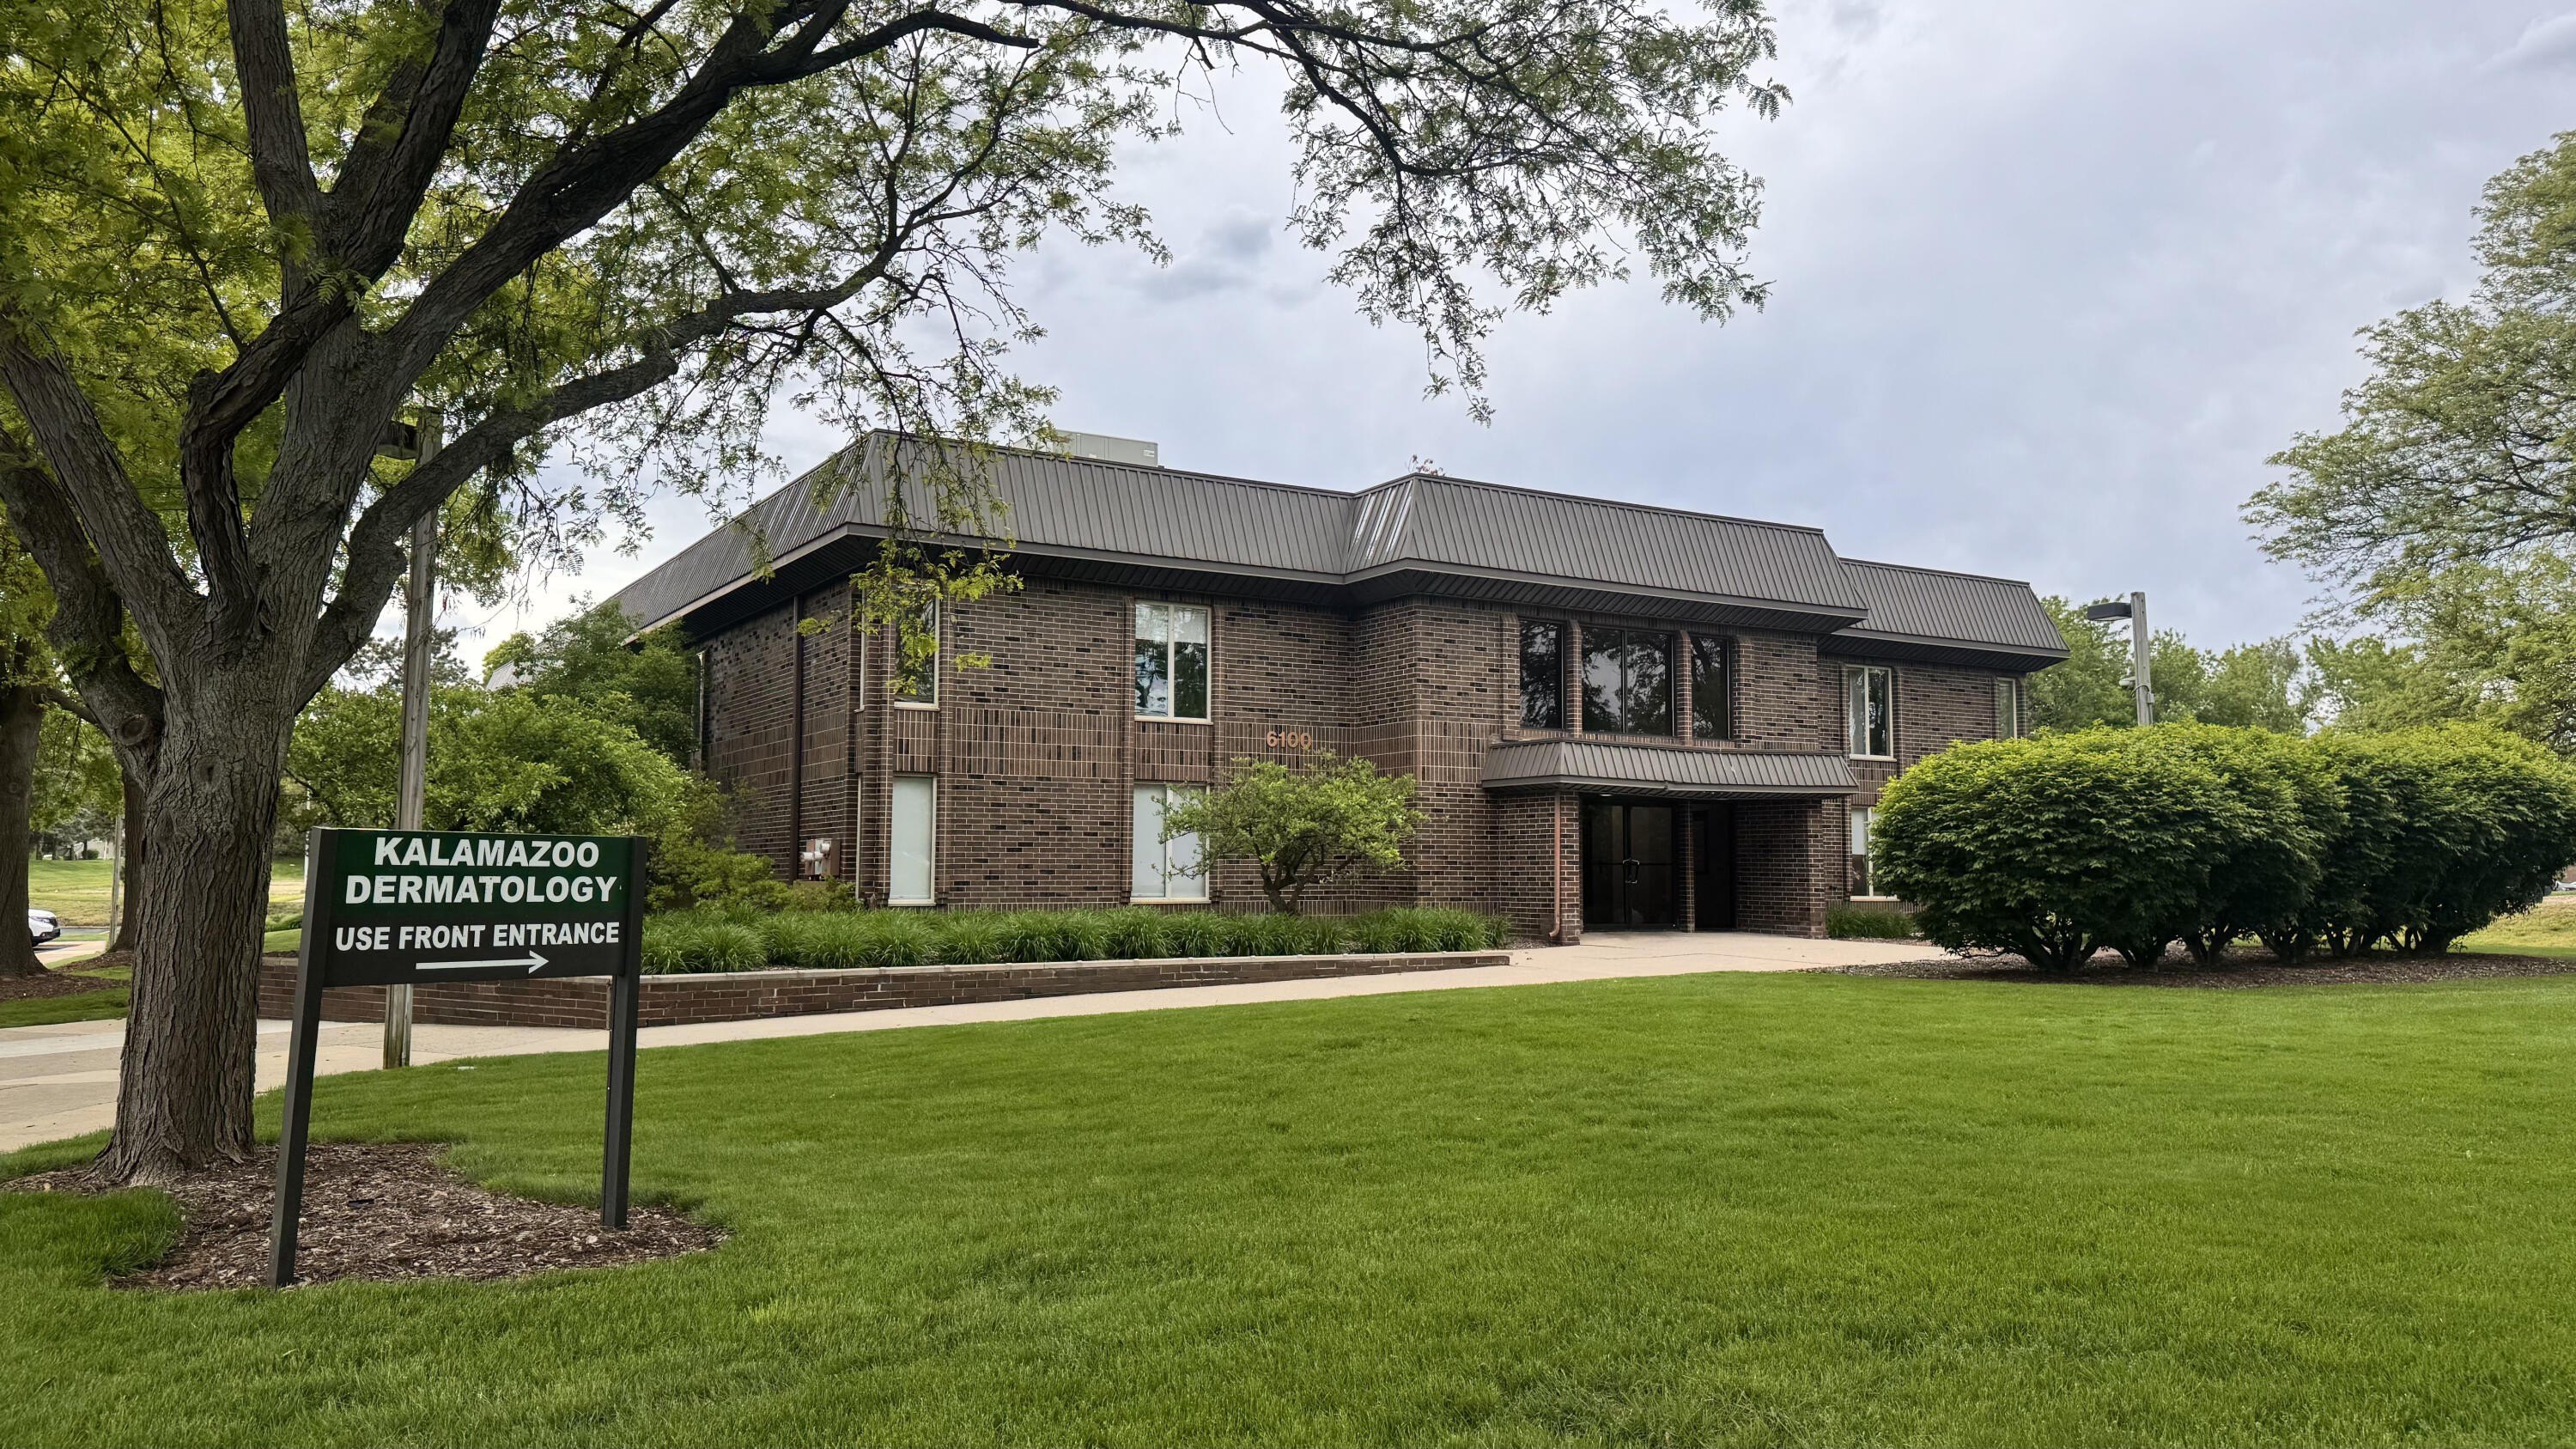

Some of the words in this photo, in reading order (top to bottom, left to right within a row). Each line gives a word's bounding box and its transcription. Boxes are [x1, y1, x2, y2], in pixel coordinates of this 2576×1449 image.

[1267, 731, 1312, 749] 6100
[374, 837, 599, 868] KALAMAZOO
[345, 874, 617, 904] DERMATOLOGY
[336, 927, 391, 952] USE
[398, 924, 486, 949] FRONT
[493, 922, 620, 947] ENTRANCE
